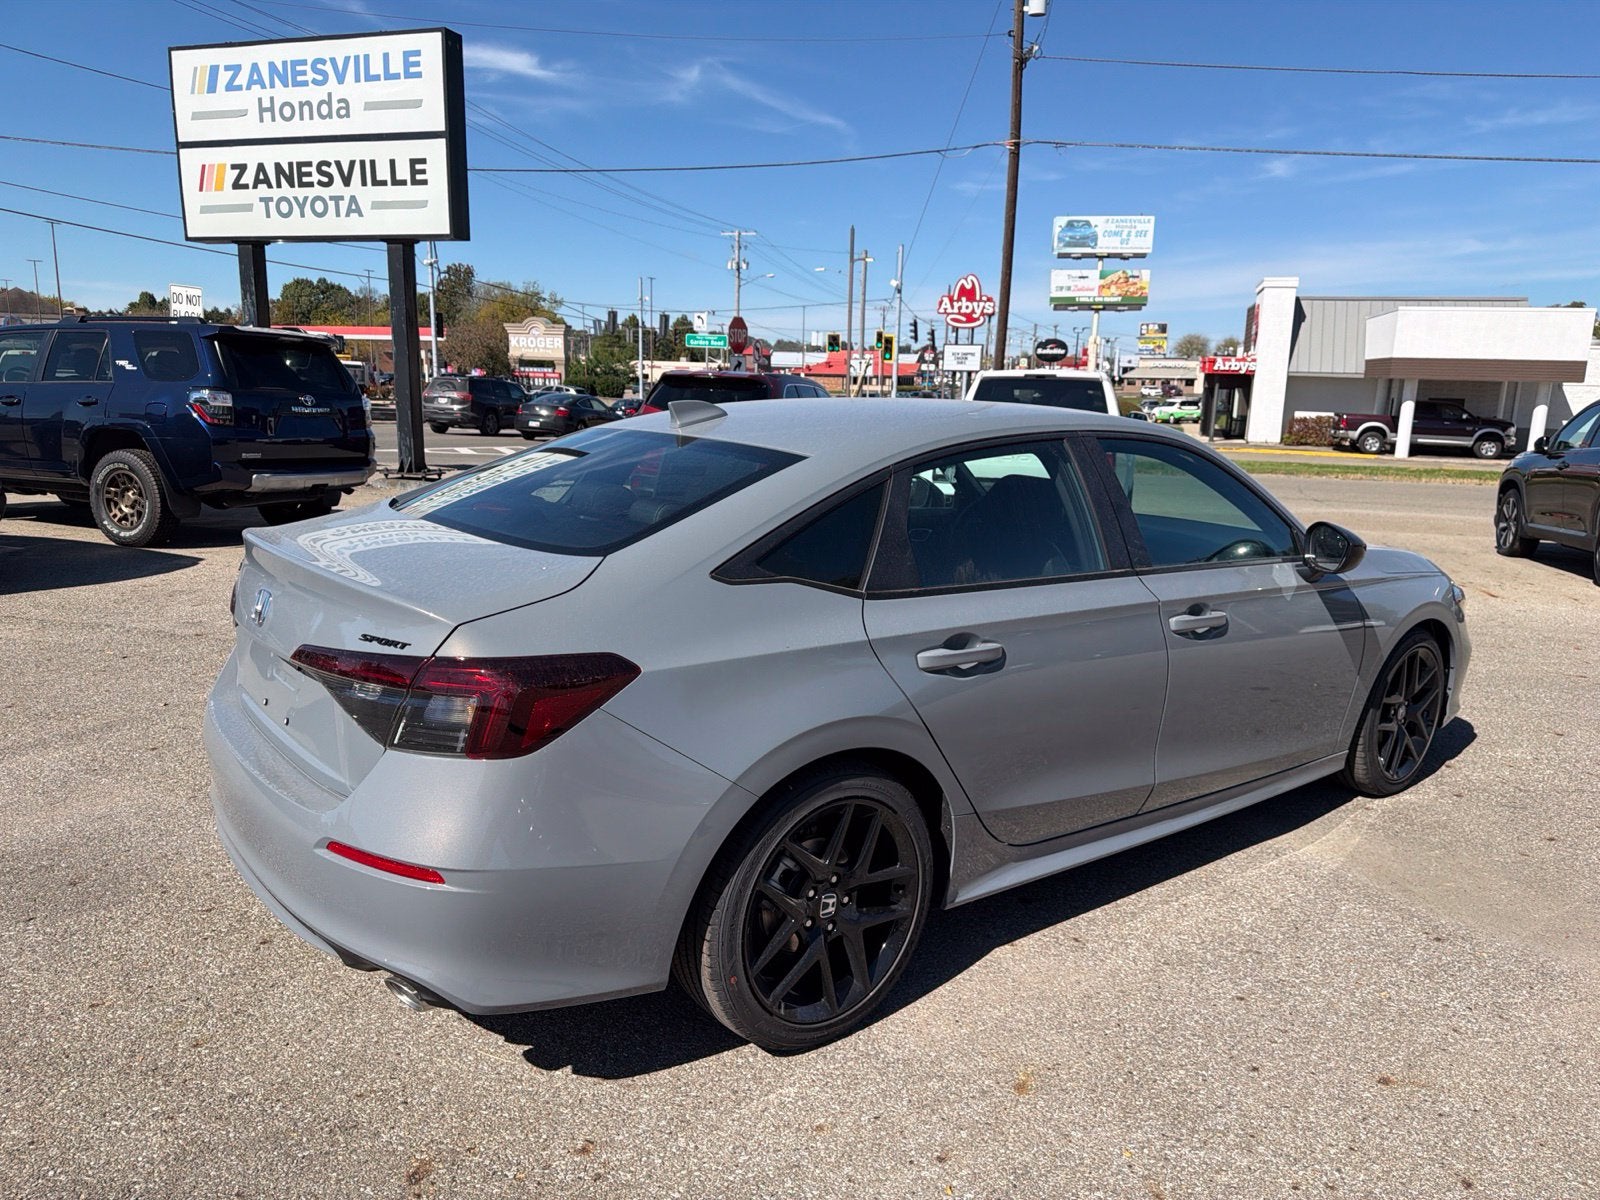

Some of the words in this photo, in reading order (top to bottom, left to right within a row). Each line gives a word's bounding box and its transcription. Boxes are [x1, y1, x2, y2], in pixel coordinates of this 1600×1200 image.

[223, 49, 423, 92] ZANESVILLE
[257, 91, 350, 123] Honda
[230, 157, 428, 190] ZANESVILLE
[258, 194, 364, 219] TOYOTA
[1102, 230, 1124, 238] COME
[1134, 230, 1149, 238] SEE
[1119, 238, 1130, 246] US
[172, 292, 184, 305] DO
[186, 294, 202, 307] NOT
[938, 296, 995, 318] Arby's
[510, 336, 562, 349] KROGER
[729, 329, 747, 343] STOP
[358, 633, 412, 650] SPORT
